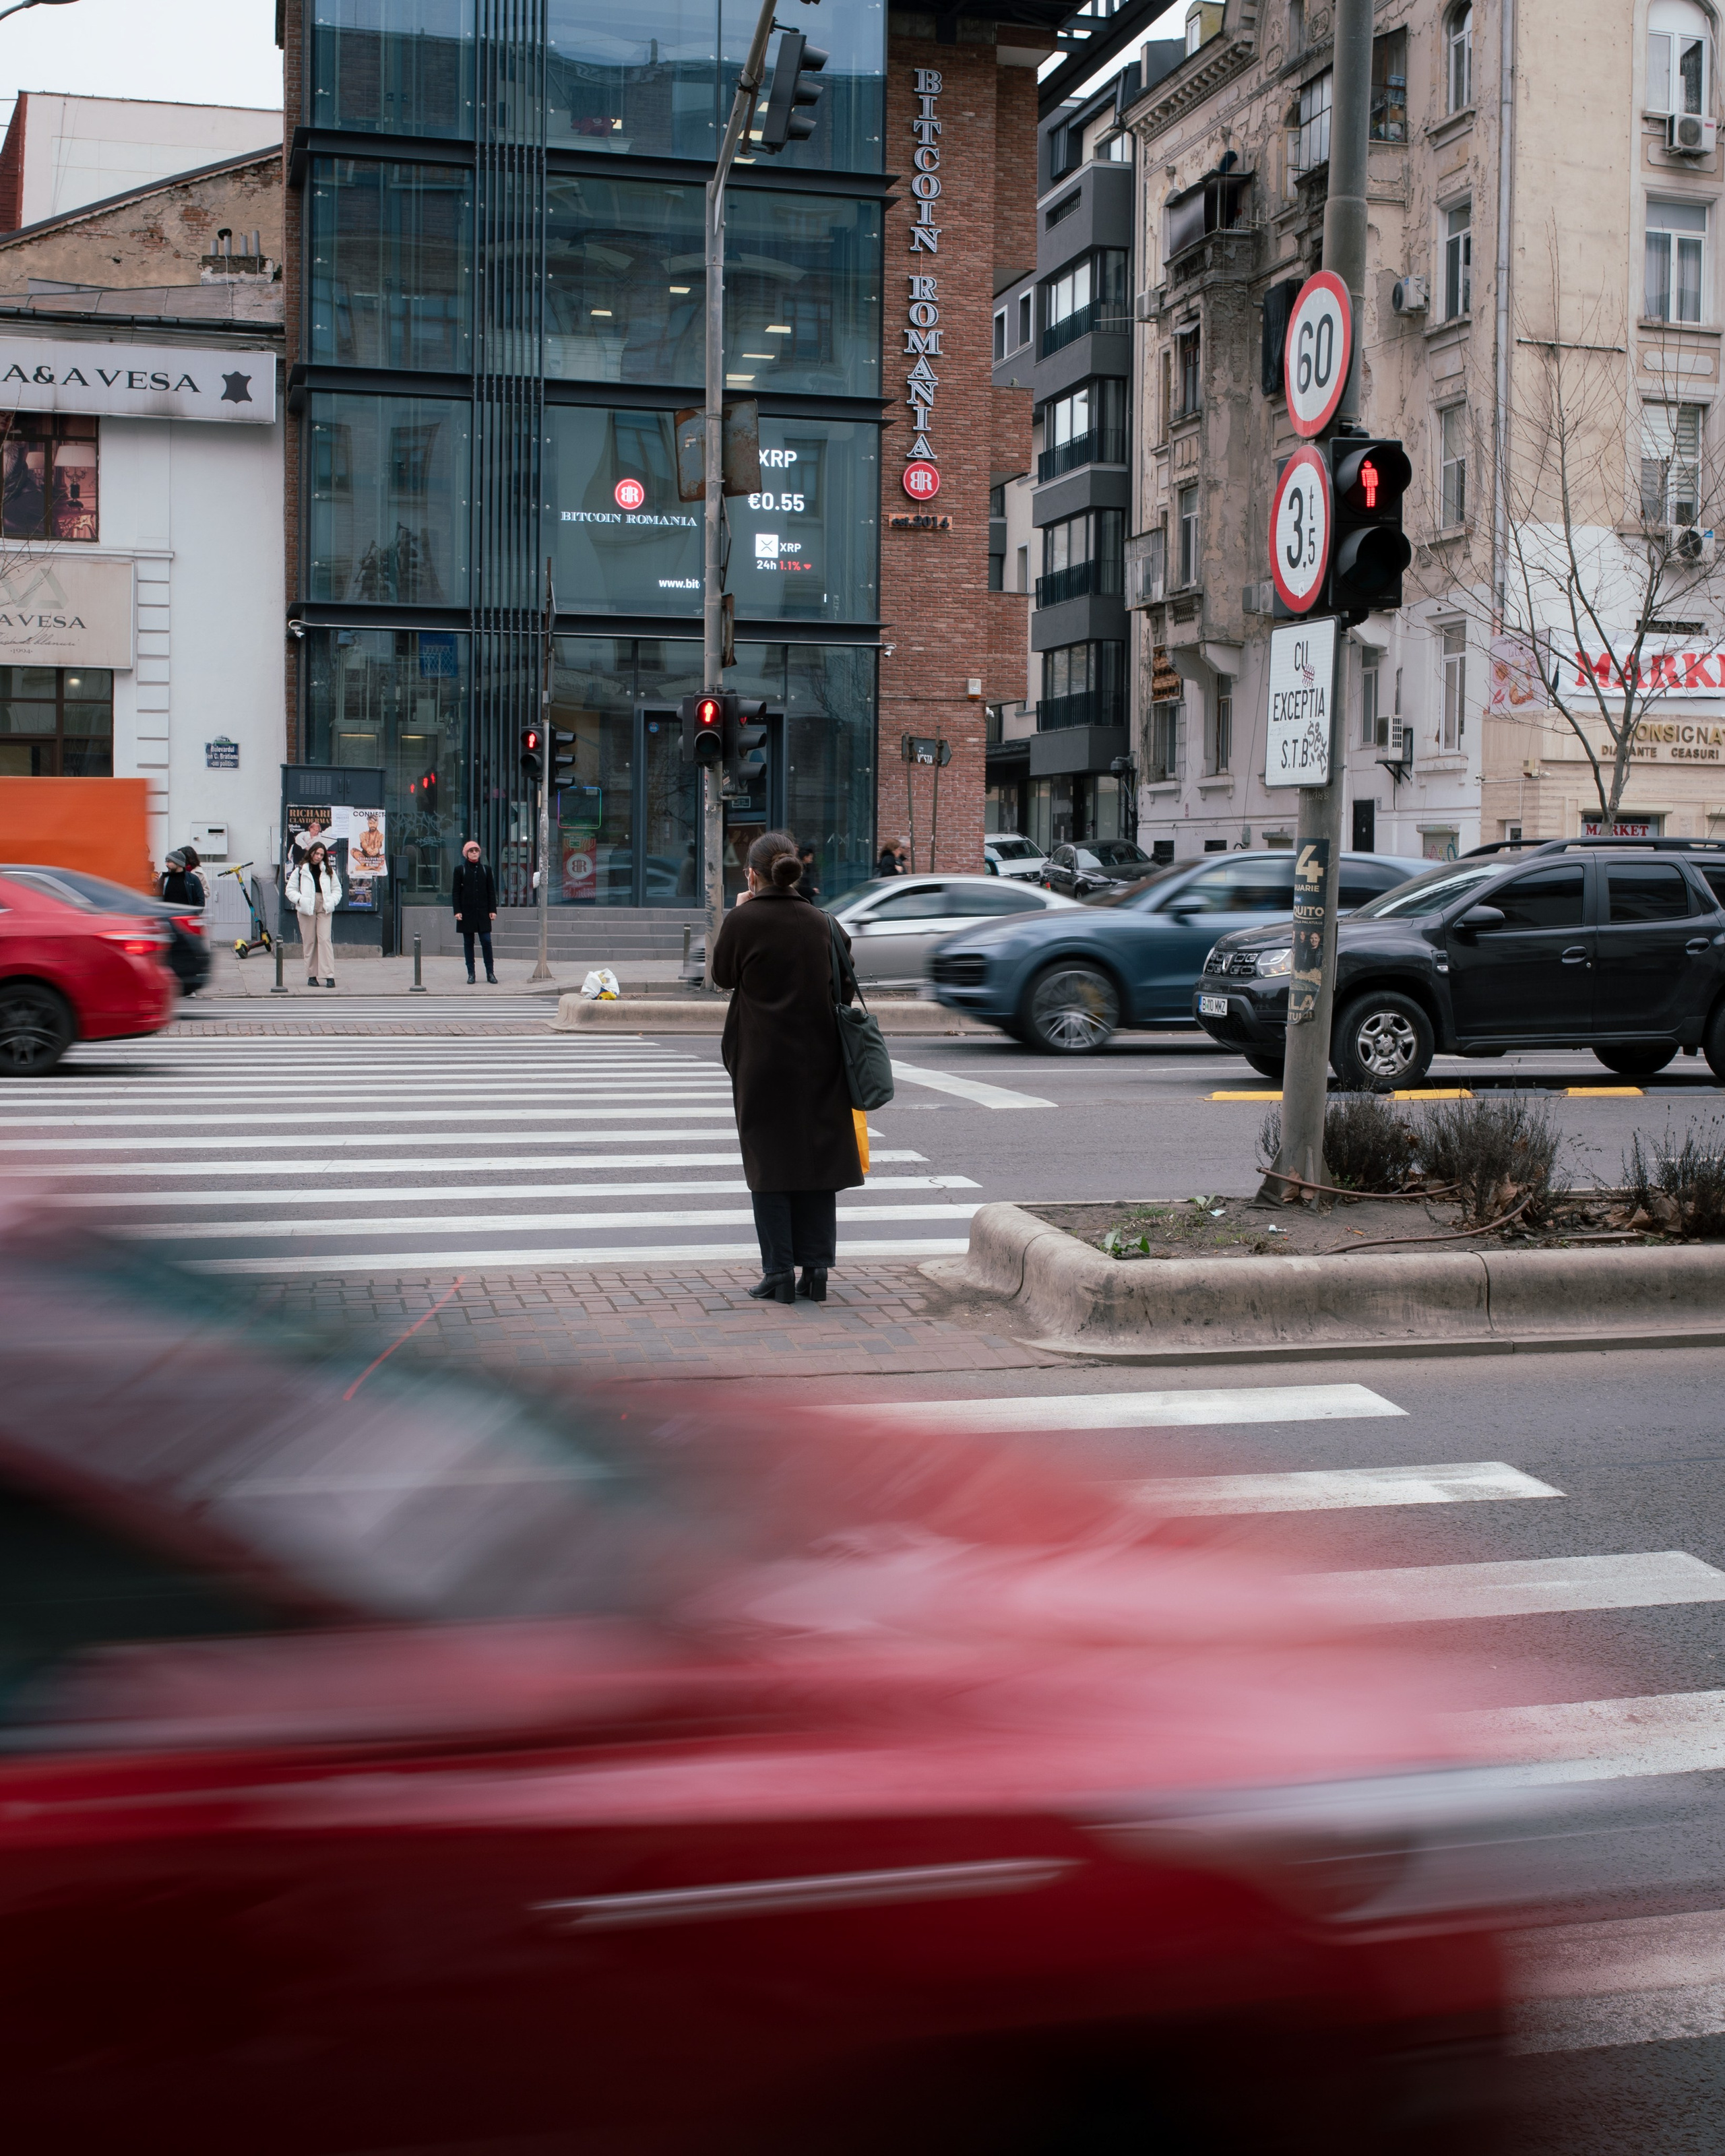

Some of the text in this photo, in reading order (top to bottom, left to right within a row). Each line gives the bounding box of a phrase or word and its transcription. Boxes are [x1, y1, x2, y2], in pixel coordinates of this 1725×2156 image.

[904, 68, 943, 459] BITCOIN ROMANIA
[1296, 313, 1334, 395] 60
[758, 449, 797, 468] XRP
[748, 493, 805, 512] €0.55
[561, 511, 697, 527] BITCOIN ROMANIA
[780, 542, 802, 552] XRP
[757, 560, 801, 571] 24h 1.1%
[658, 579, 701, 590] www.bit
[1294, 640, 1309, 672] CU
[1575, 651, 1725, 689] MARK
[1272, 687, 1325, 722] EXCEPTIA
[1627, 723, 1725, 746] ONSIGNA
[917, 753, 933, 764] VSTA
[1602, 744, 1719, 760] DIAANTE CEASURI
[1586, 824, 1649, 837] MRKET
